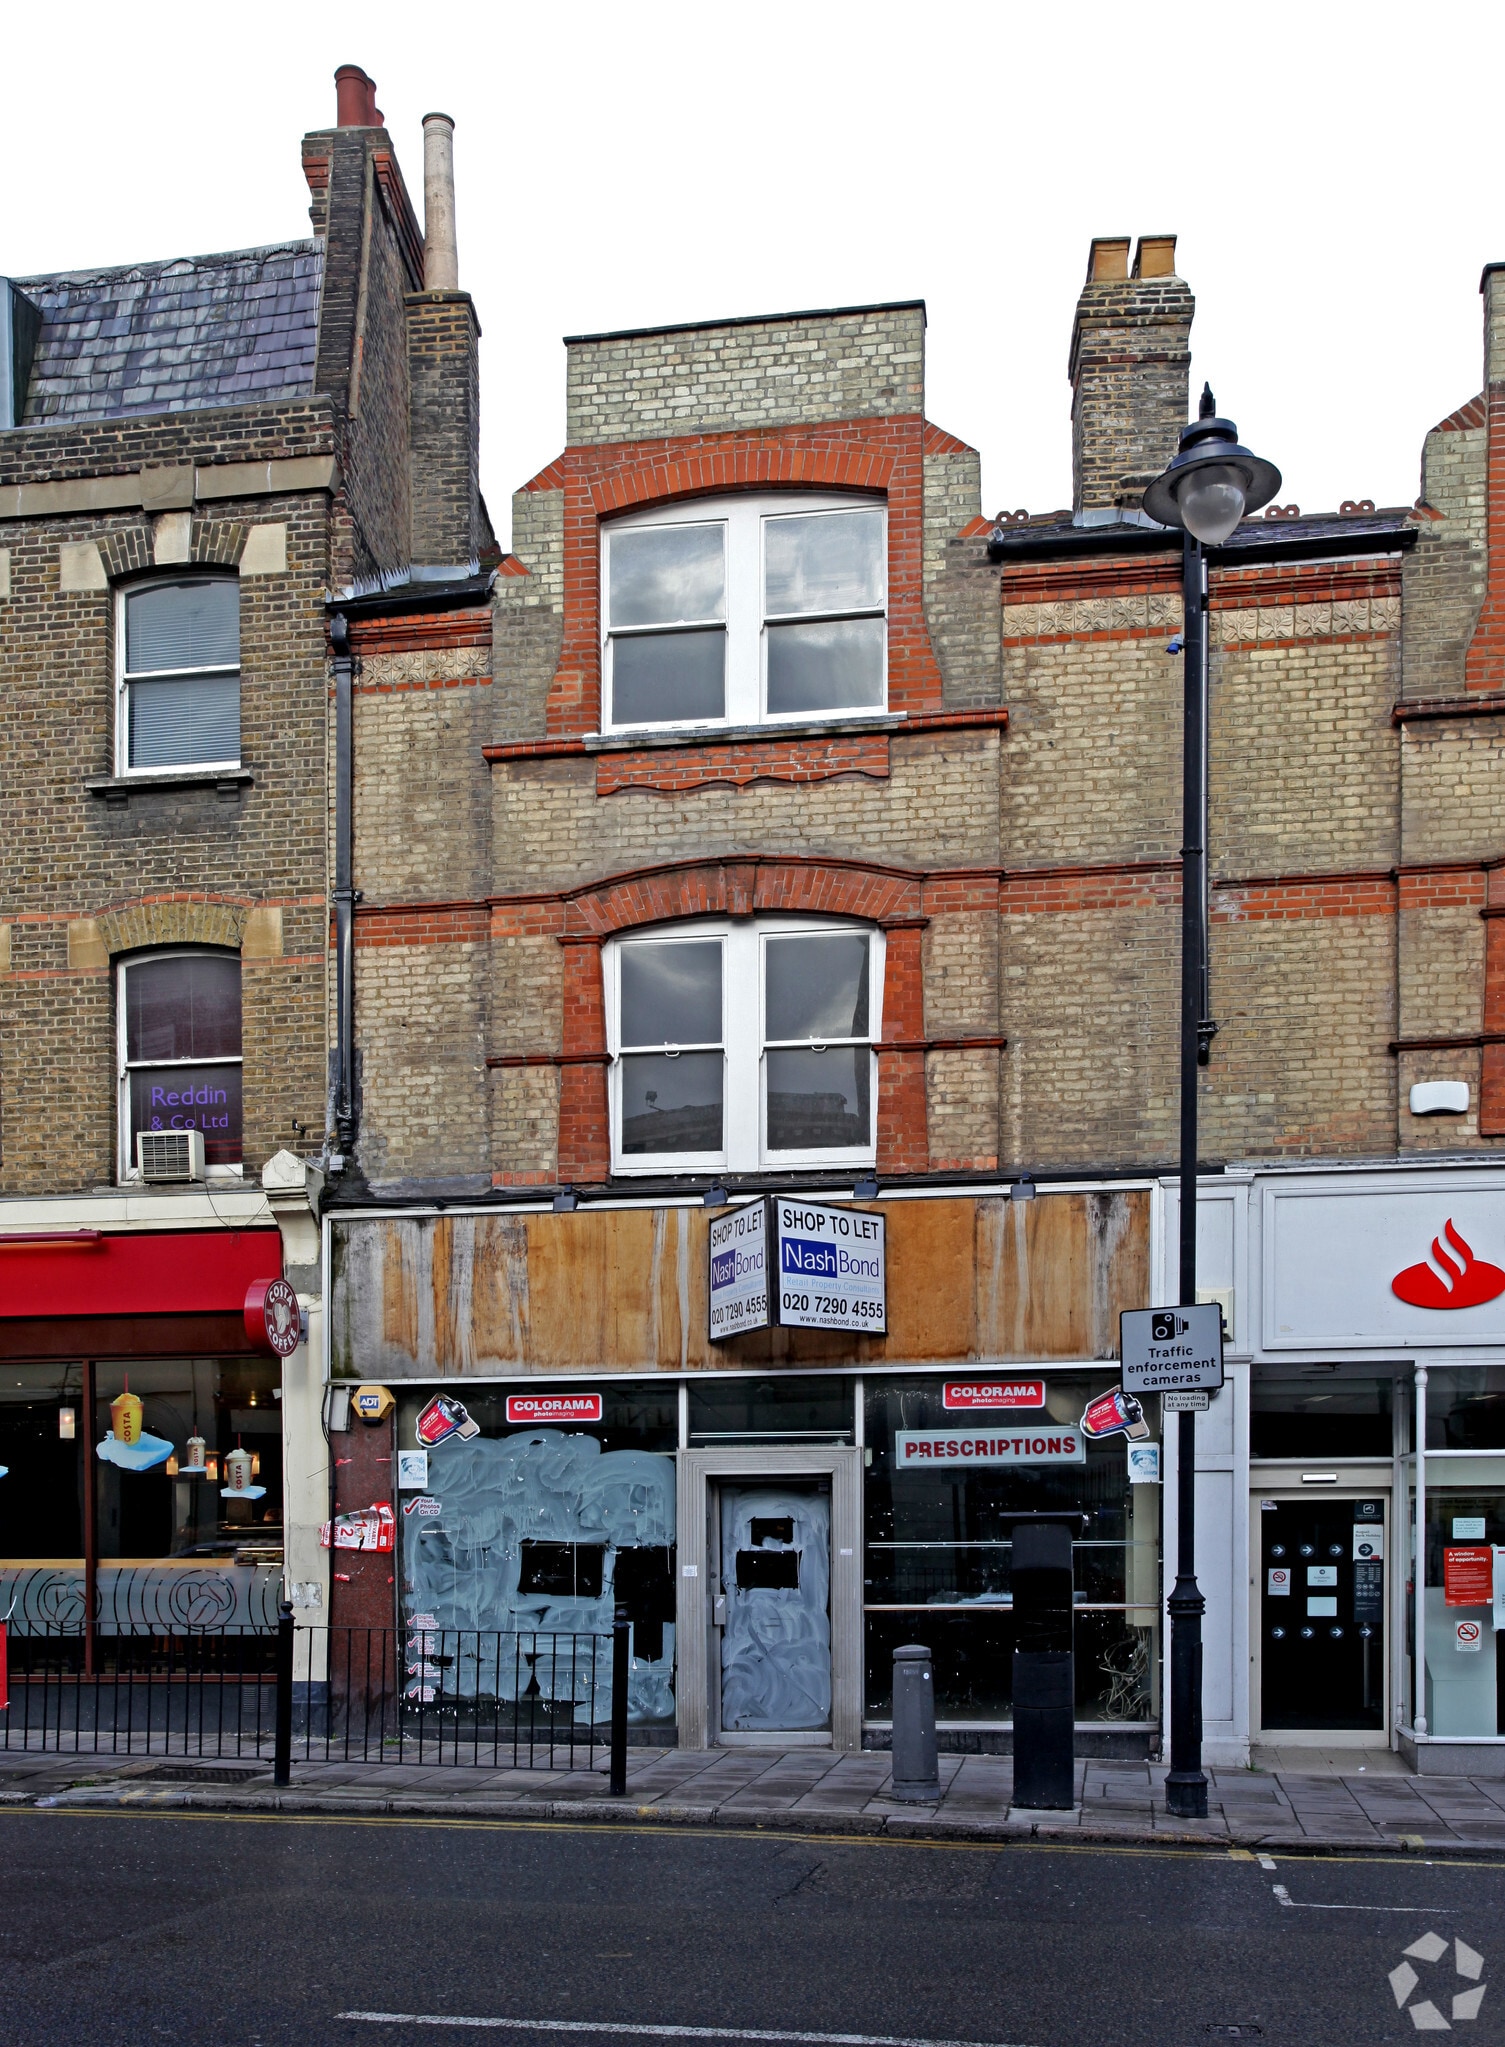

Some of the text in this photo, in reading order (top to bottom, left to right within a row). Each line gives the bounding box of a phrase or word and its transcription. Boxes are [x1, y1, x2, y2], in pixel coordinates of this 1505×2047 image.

[151, 1084, 227, 1107] Reddin
[150, 1112, 229, 1131] & Co Ltd
[712, 1209, 763, 1247] SHOP TO LET
[783, 1208, 879, 1240] SHOP TO LET
[787, 1276, 880, 1294] Retail Property Consultants
[269, 1285, 293, 1308] COSTA
[783, 1293, 883, 1319] 020 7290 4555
[712, 1294, 767, 1325] 020 7290 4555
[799, 1315, 869, 1328] www.nashbond.co.uk
[268, 1324, 297, 1350] COFFEE
[1147, 1345, 1194, 1358] Traffic
[1127, 1357, 1217, 1373] enforcement
[1142, 1373, 1201, 1386] cameras
[950, 1385, 1037, 1398] COLORAMA
[1179, 1394, 1206, 1402] loading
[360, 1397, 379, 1407] ADT
[513, 1399, 595, 1411] COLORAMA
[123, 1411, 131, 1442] COSTA
[905, 1436, 1076, 1459] PRESCRIPTIONS
